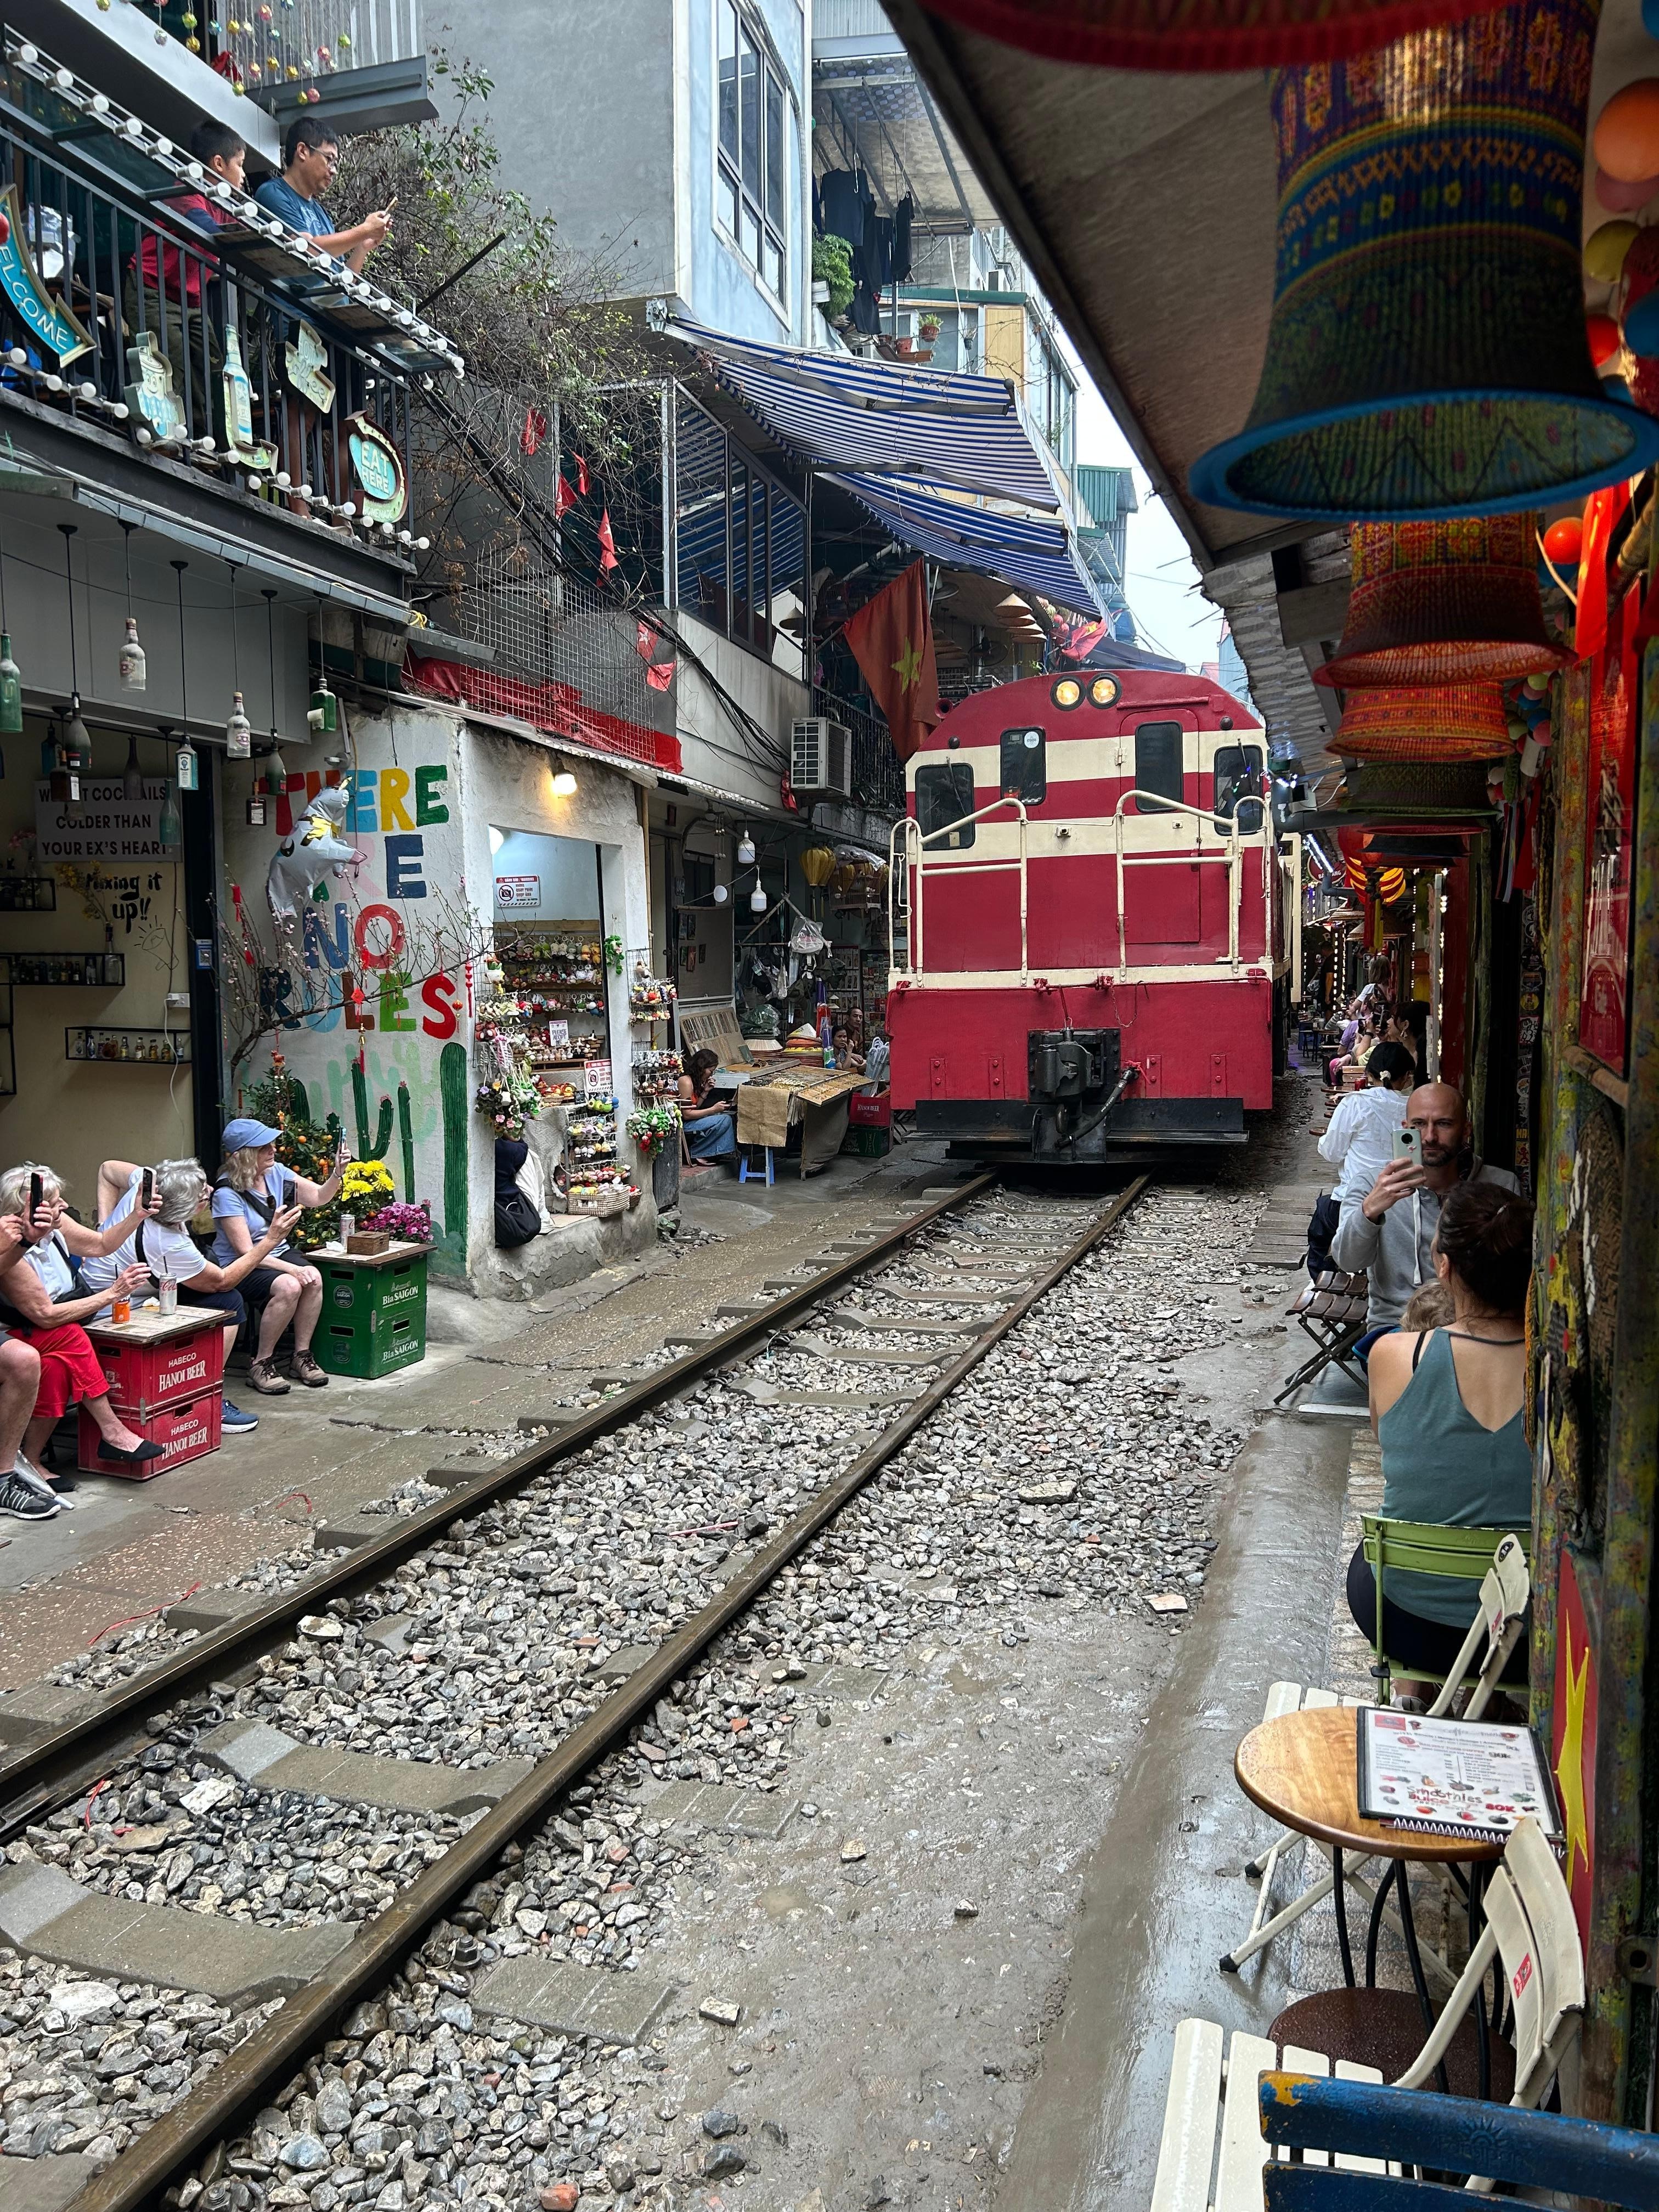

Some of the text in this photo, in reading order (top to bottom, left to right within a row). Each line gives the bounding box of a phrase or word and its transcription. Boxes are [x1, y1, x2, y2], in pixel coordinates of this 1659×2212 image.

[0, 246, 68, 350] ELCOME
[362, 443, 390, 477] EAT
[362, 466, 390, 495] HERE
[56, 814, 151, 830] COLDER THAN
[42, 842, 82, 855] YOUR
[313, 834, 427, 902] RE
[148, 872, 163, 891] it
[302, 903, 405, 969] NO
[259, 967, 457, 1040] RULES
[382, 1285, 419, 1306] Bia SAIGON
[168, 1352, 197, 1368] HABECO
[383, 1339, 419, 1362] Bia SAIGON
[159, 1360, 207, 1393] HANOI BEER
[171, 1419, 199, 1436] HABECO
[189, 1426, 207, 1447] BEER
